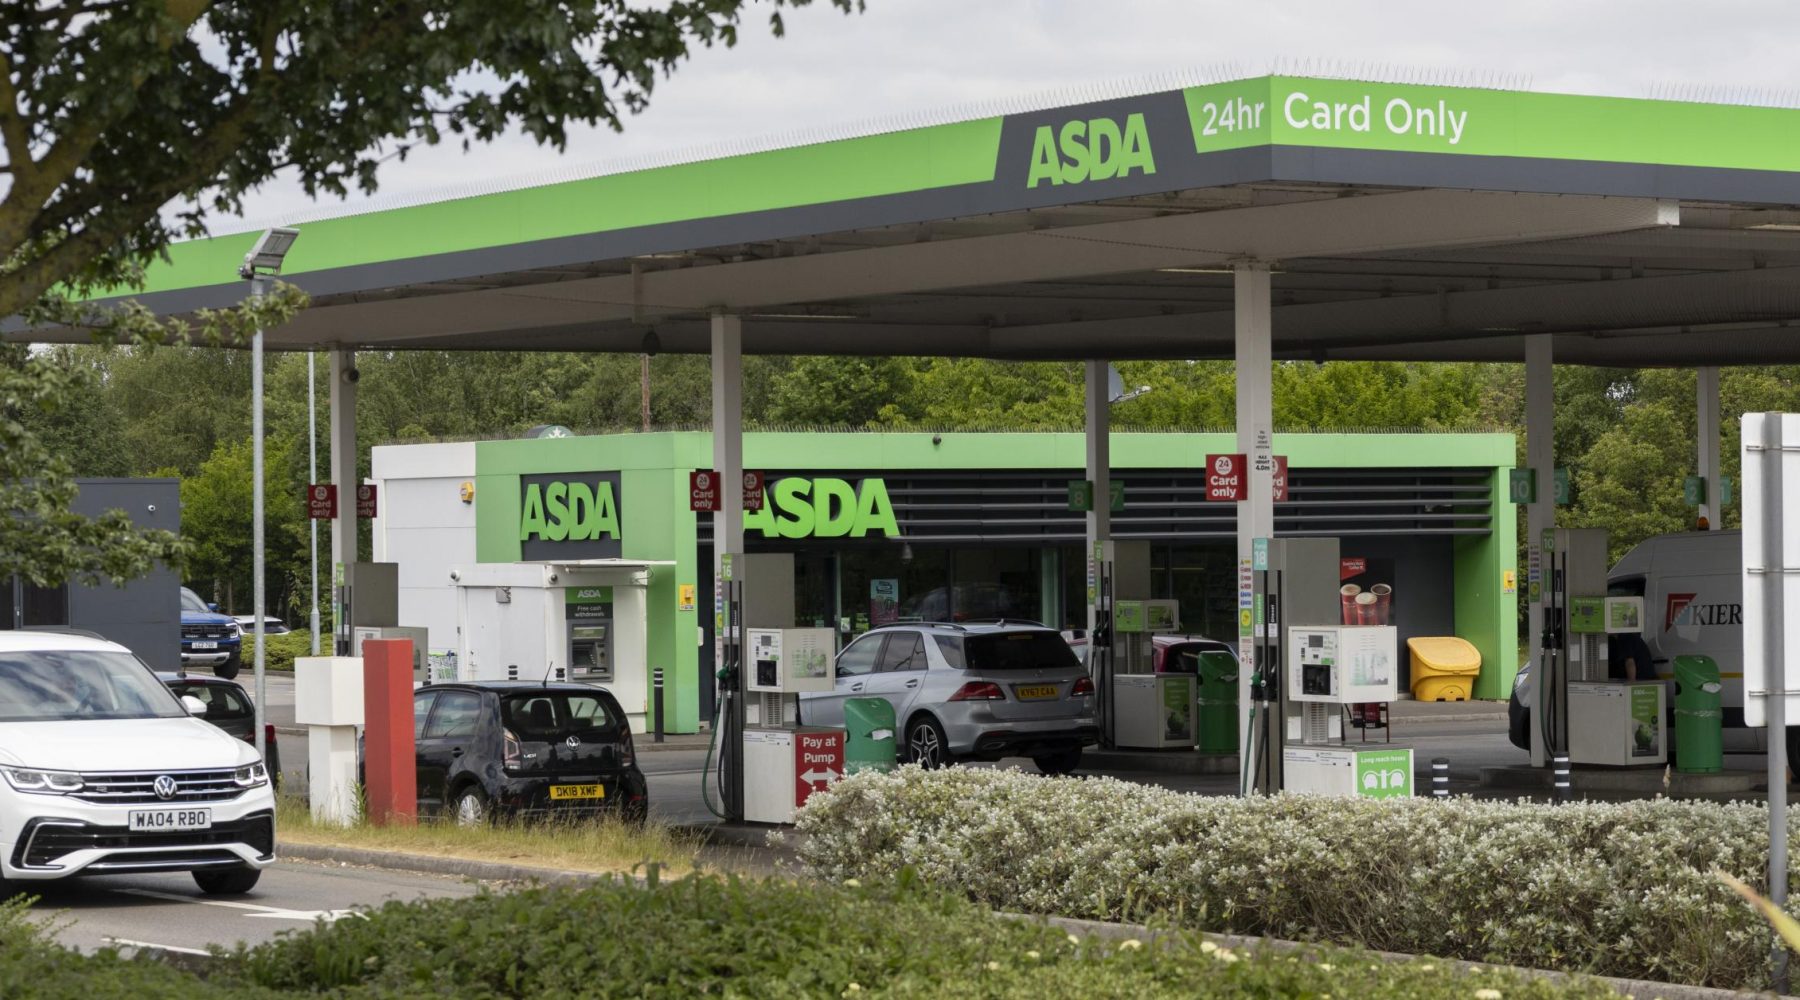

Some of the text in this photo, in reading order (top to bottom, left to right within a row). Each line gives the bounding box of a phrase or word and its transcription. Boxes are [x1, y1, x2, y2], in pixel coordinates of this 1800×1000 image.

[1202, 91, 1468, 144] 24hr Card Only
[1027, 112, 1157, 189] ASDA
[1218, 460, 1229, 468] 24
[1210, 475, 1238, 486] Card
[693, 489, 714, 498] Card
[1211, 486, 1237, 498] only
[1511, 481, 1529, 498] 10
[1690, 487, 1698, 500] 2
[694, 499, 713, 508] only
[1074, 491, 1084, 504] 8
[311, 500, 331, 508] Card
[312, 508, 331, 516] only
[520, 481, 620, 541] ASDA
[1544, 539, 1554, 550] 10
[1254, 551, 1265, 565] 18
[722, 565, 732, 577] 16
[577, 590, 601, 598] ASDA
[1692, 603, 1743, 626] KIER
[802, 737, 823, 749] Pay
[825, 737, 836, 747] at
[804, 752, 835, 764] Pump
[556, 785, 598, 797] DK18 XMF
[136, 811, 206, 827] WA04 RBO
